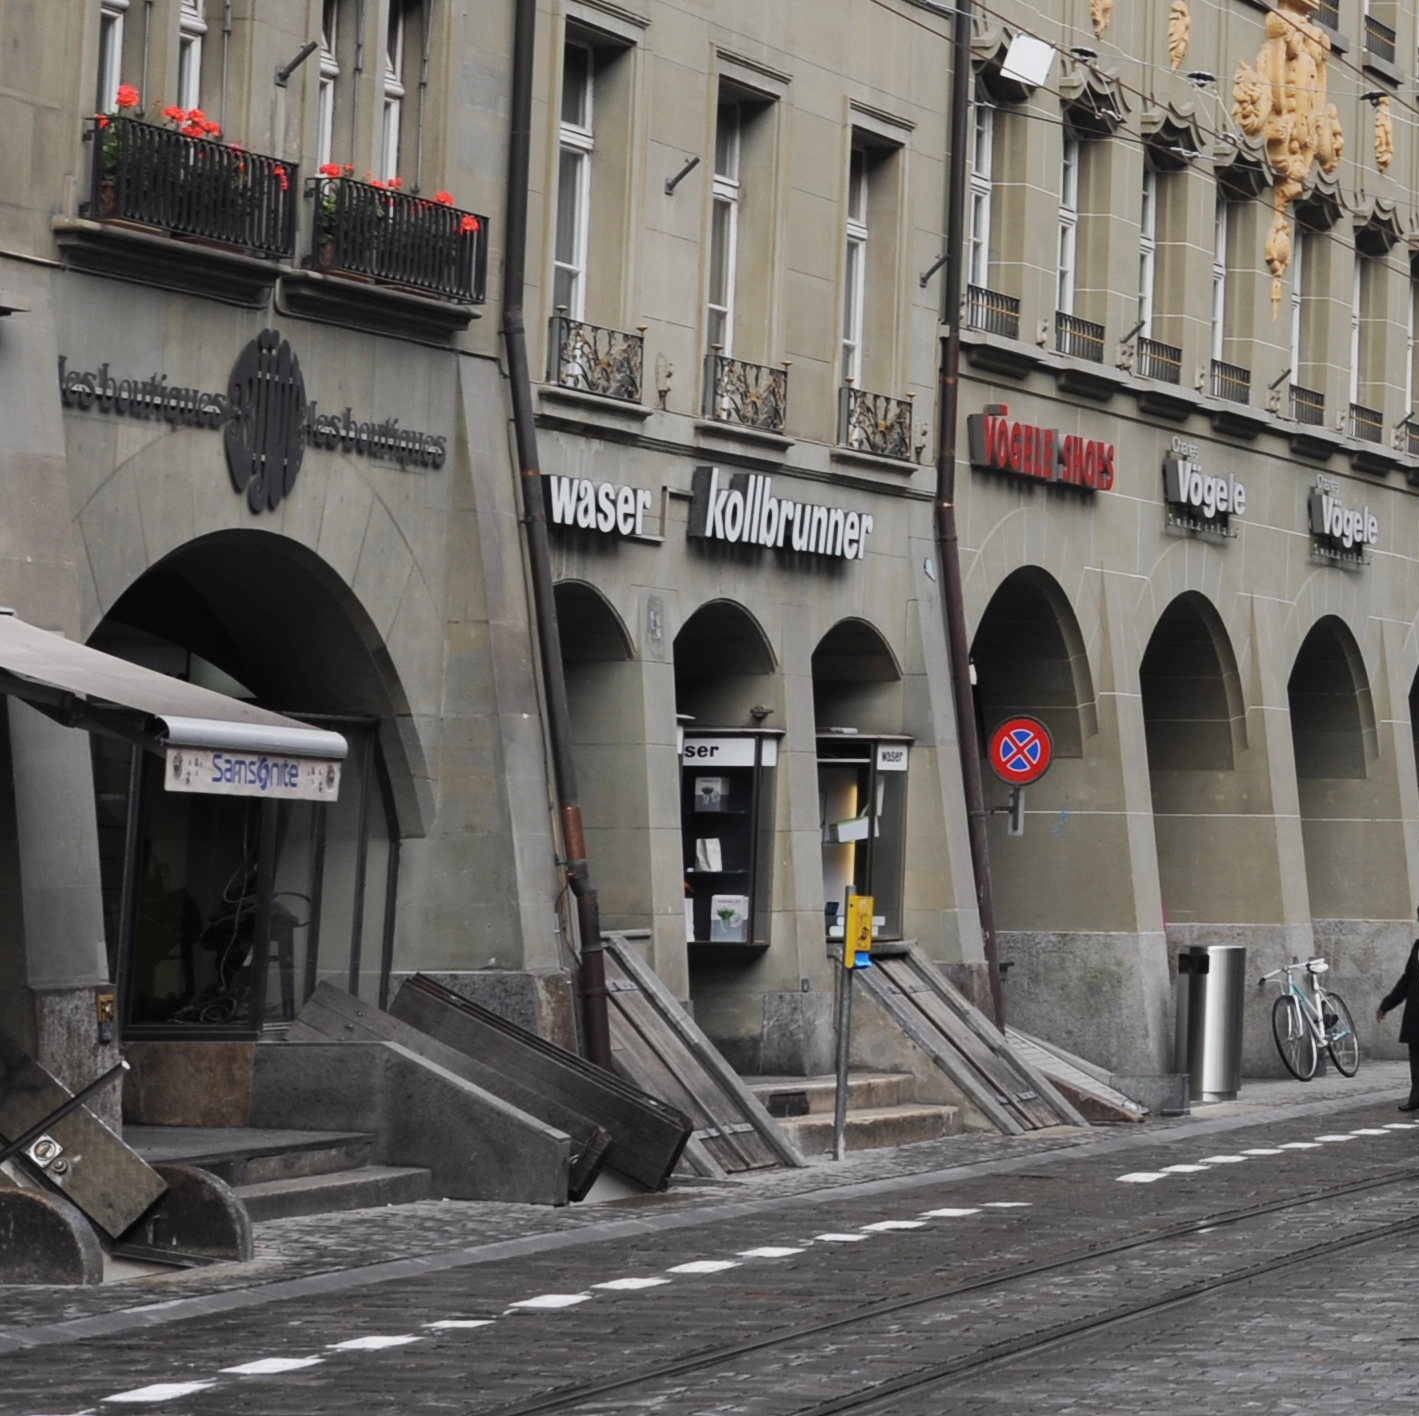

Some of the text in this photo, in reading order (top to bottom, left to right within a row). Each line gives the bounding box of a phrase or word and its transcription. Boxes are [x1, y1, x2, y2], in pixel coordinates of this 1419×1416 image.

[100, 362, 226, 431] boutiques
[342, 406, 448, 472] boutiques
[1062, 434, 1115, 491] SHOES
[1178, 459, 1246, 518] Vögele
[549, 466, 874, 560] waser kollbrunner
[1322, 494, 1378, 549] Vögele
[211, 753, 299, 791] Samsonite
[881, 750, 904, 763] waser
